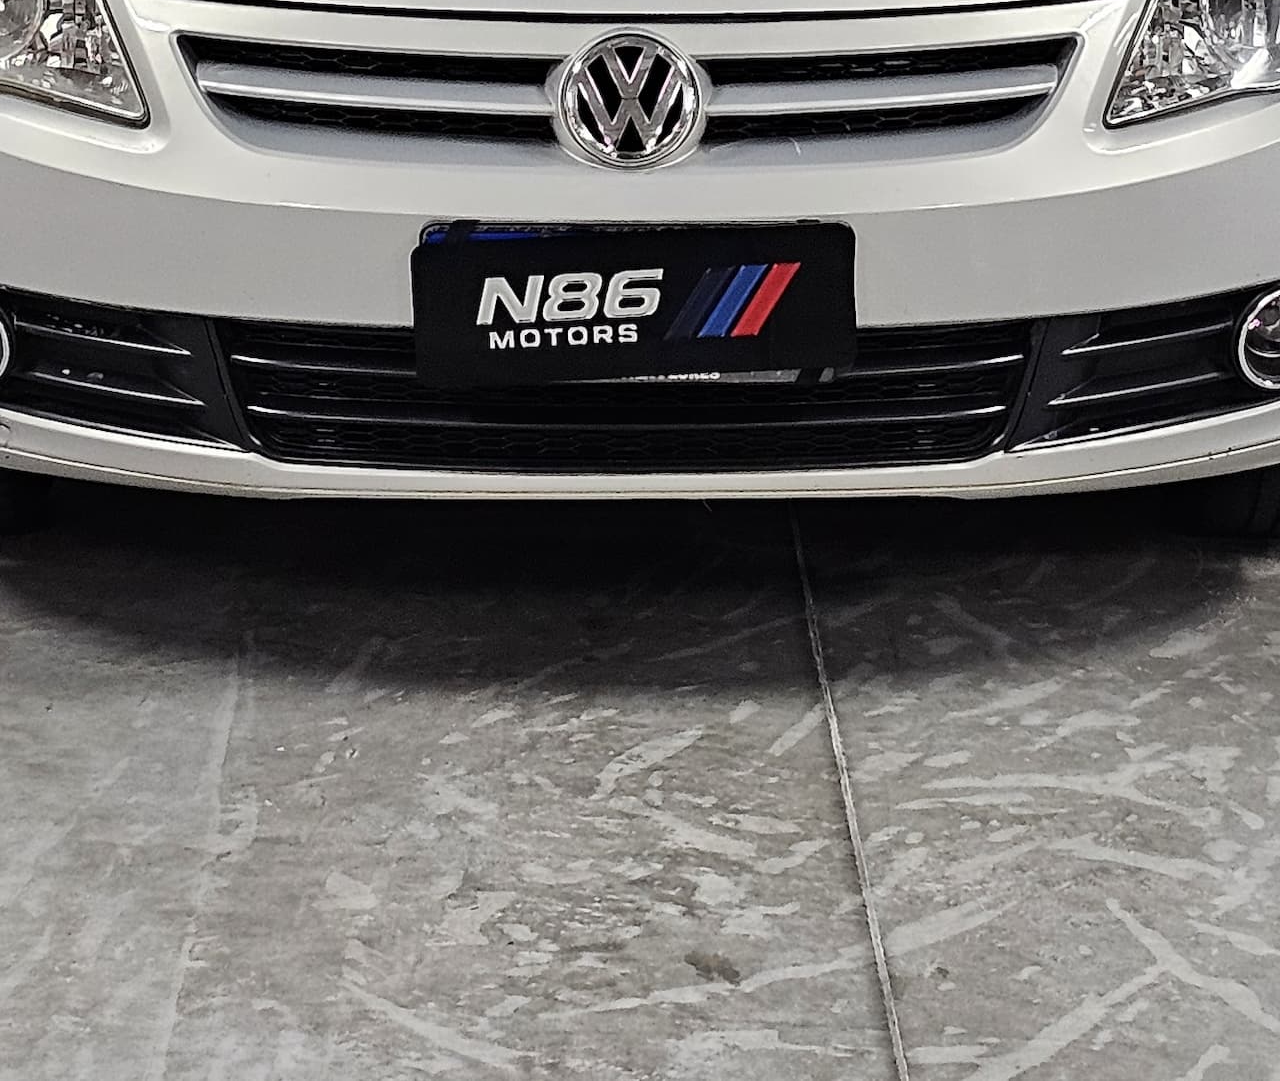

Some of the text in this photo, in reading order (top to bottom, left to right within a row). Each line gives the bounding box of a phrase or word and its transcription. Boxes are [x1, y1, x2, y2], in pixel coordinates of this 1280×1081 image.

[570, 40, 690, 157] VW
[476, 268, 664, 326] N86
[488, 323, 639, 350] MOTORS
